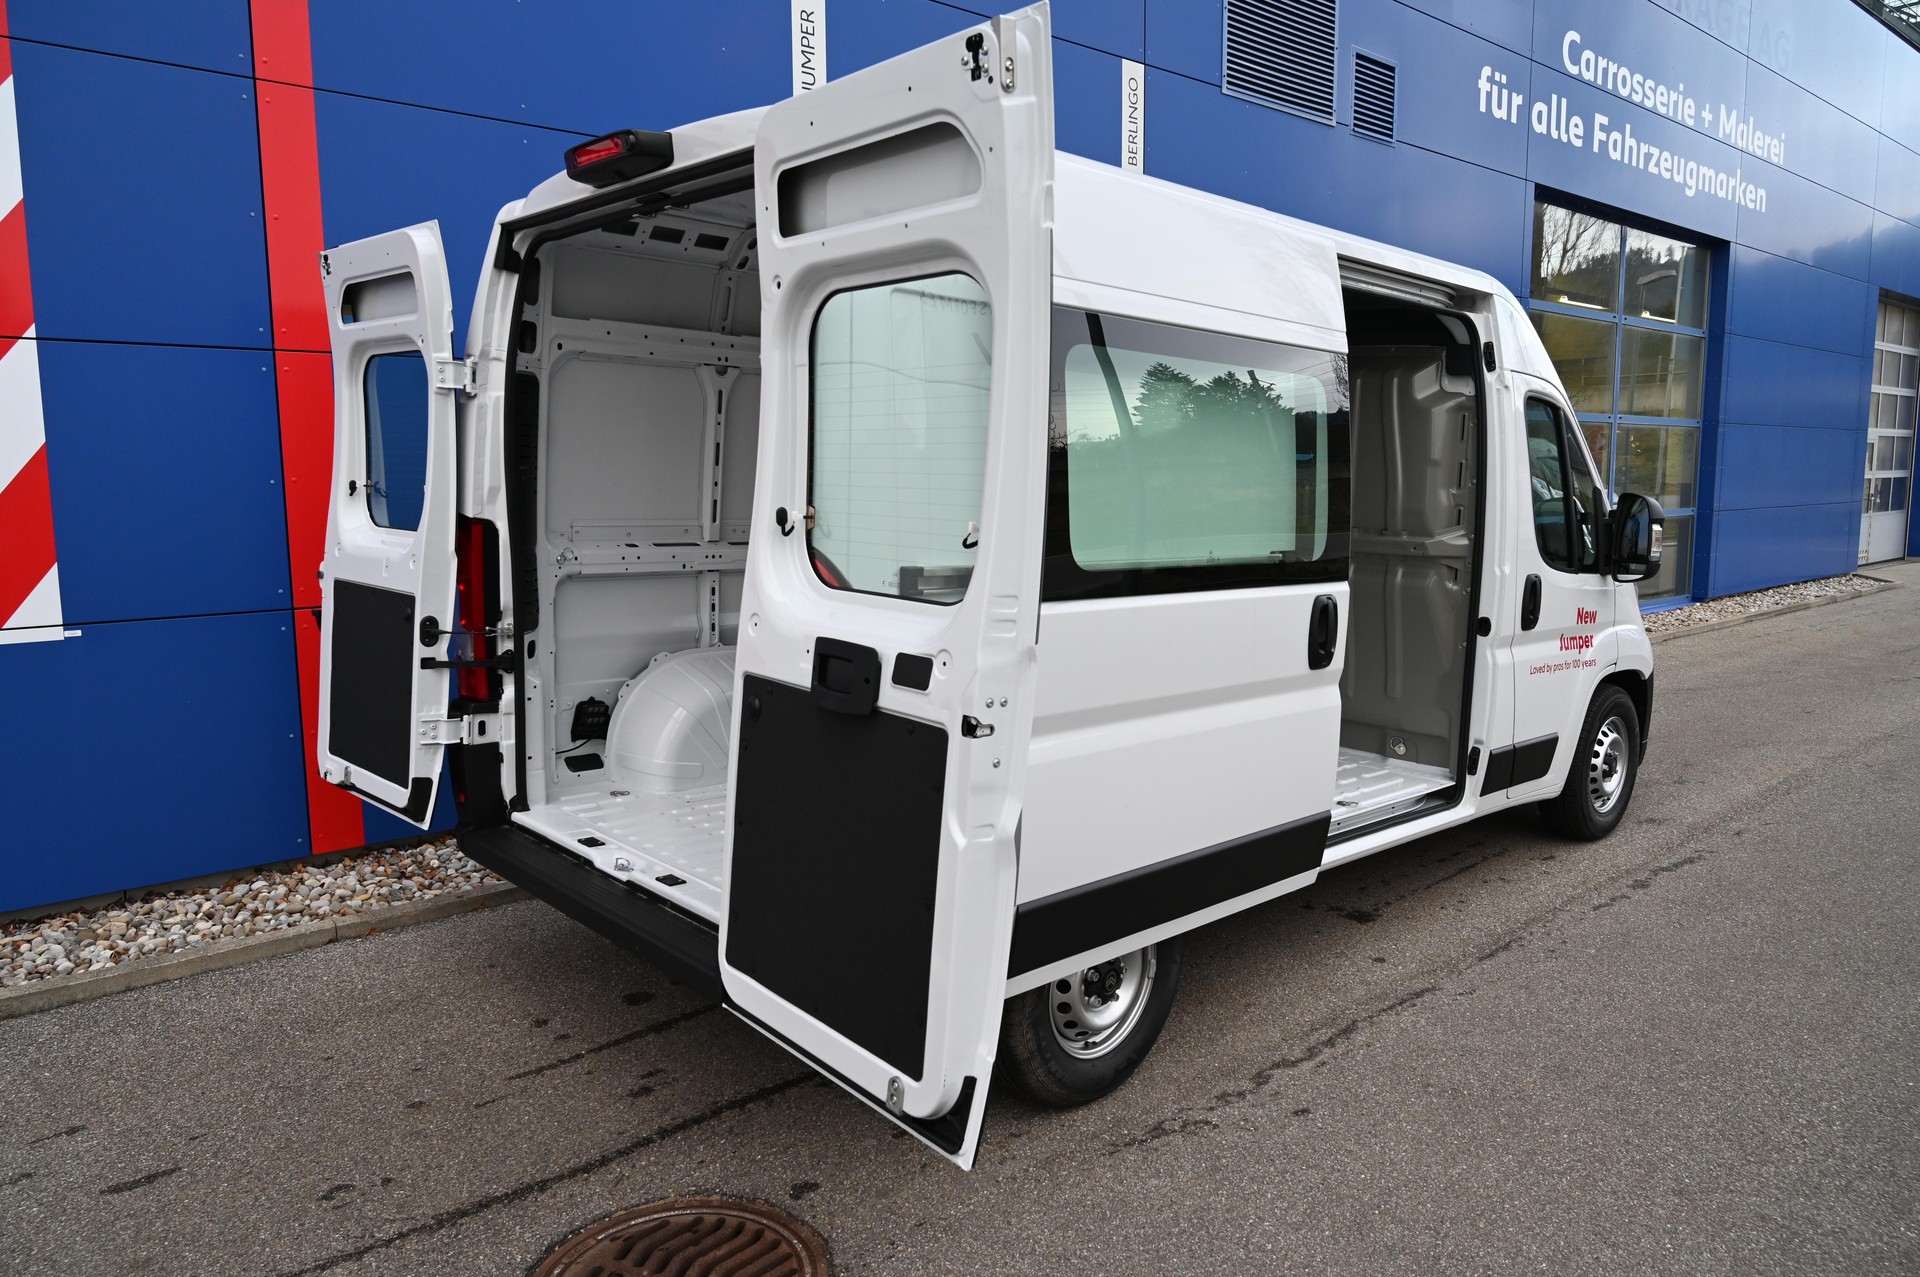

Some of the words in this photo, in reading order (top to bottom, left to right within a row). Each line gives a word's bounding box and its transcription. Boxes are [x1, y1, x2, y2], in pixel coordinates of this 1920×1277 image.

[1127, 77, 1139, 167] BERLINGO
[1562, 30, 1696, 127] Carrosserie
[1701, 106, 1713, 129] +
[1718, 103, 1786, 166] Malerei
[1478, 65, 1523, 124] für
[1532, 93, 1584, 148] alle
[1593, 113, 1767, 214] Fahrzeugmarken
[1559, 633, 1594, 655] Jumper
[1576, 607, 1598, 625] New
[1529, 662, 1546, 675] Loved
[1546, 662, 1553, 675] by
[1553, 662, 1564, 674] pros
[1564, 660, 1572, 670] for
[1572, 659, 1581, 669] 100
[1581, 658, 1597, 671] years
